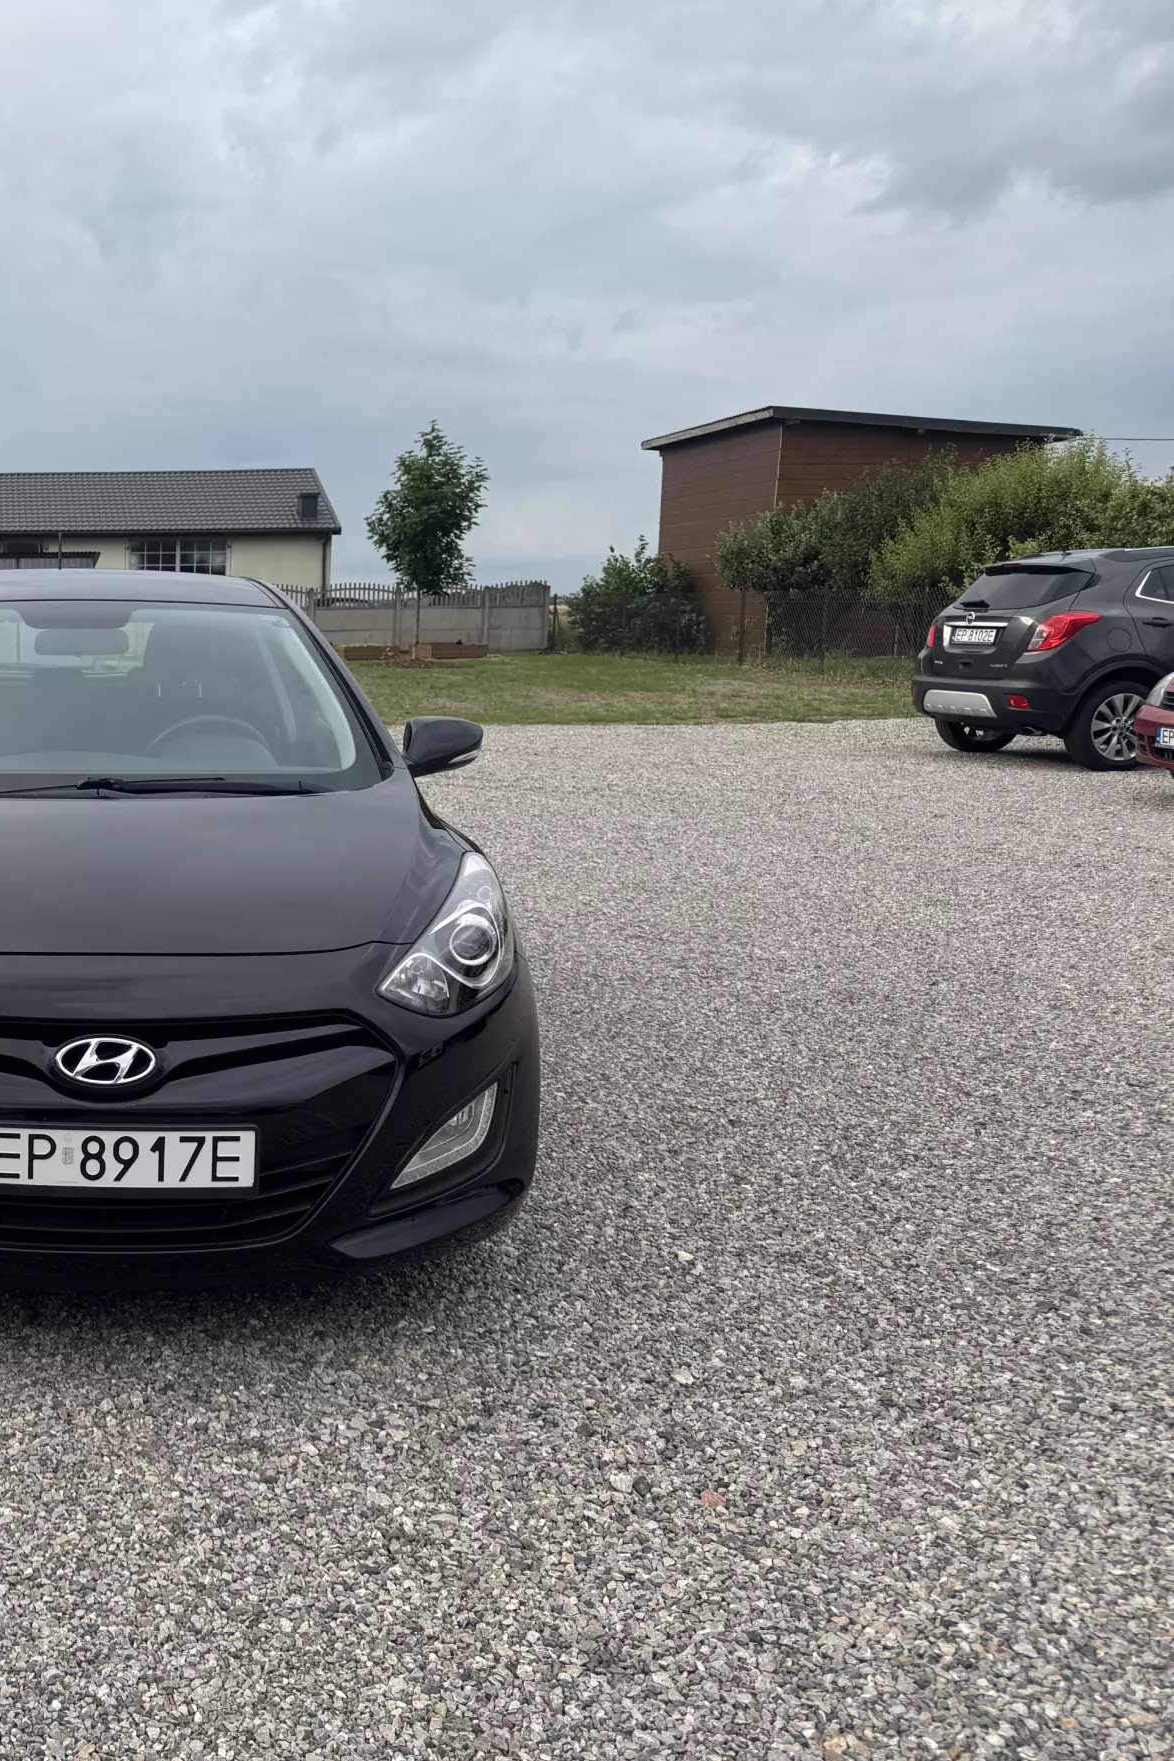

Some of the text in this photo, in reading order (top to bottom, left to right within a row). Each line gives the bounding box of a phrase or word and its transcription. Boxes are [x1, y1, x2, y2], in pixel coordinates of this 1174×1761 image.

[956, 629, 995, 642] EP 8102E
[79, 1135, 241, 1183] 8917E
